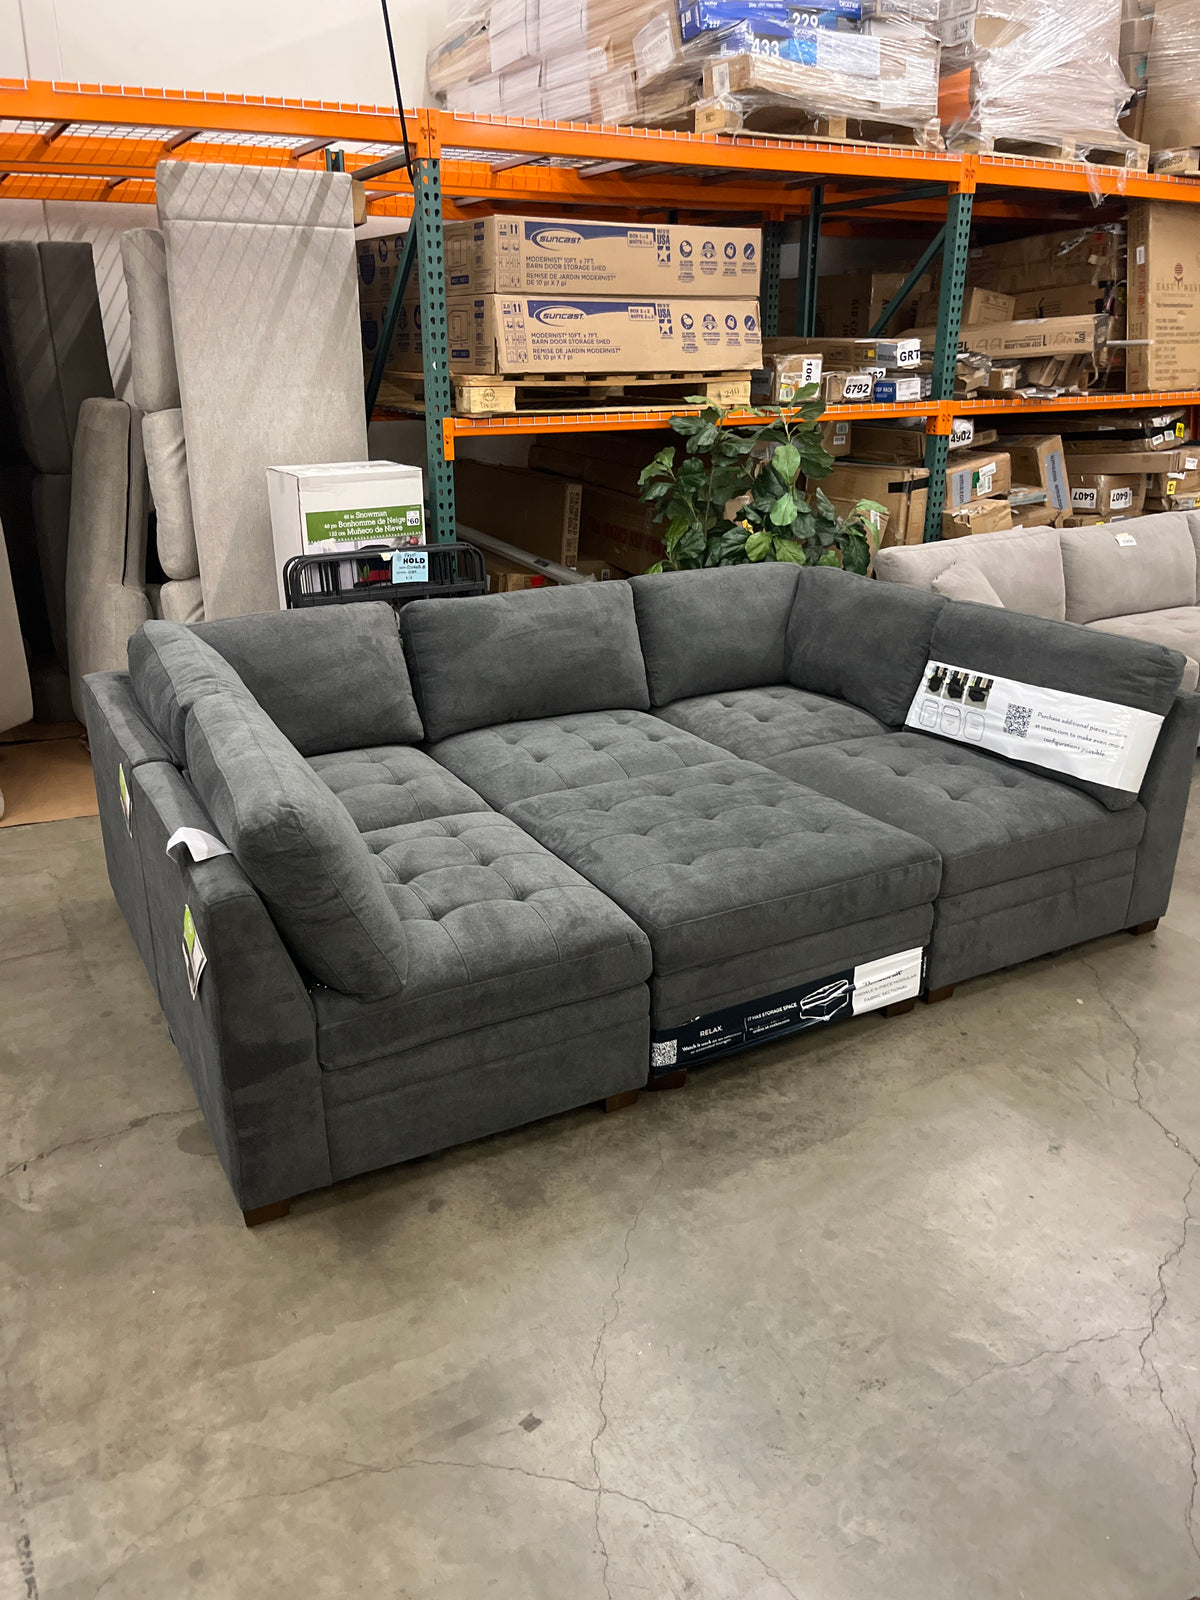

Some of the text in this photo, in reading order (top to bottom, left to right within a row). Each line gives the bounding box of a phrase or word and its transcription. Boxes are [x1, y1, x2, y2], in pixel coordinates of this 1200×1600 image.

[792, 12, 819, 28] 229
[751, 38, 780, 57] 433
[657, 234, 670, 245] USA
[658, 308, 671, 318] USA
[899, 350, 920, 362] GRT
[845, 383, 870, 395] 6792
[951, 431, 971, 443] 4902
[1073, 491, 1095, 501] 6407
[1112, 491, 1128, 502] 6407
[356, 511, 388, 519] Snowman
[338, 519, 376, 528] Bonhomme
[387, 516, 406, 525] Neige
[347, 528, 373, 536] Muñeco
[384, 525, 403, 533] Nieve
[1037, 711, 1061, 722] Purchase
[1061, 718, 1089, 729] additional
[1089, 726, 1108, 734] pieces
[1041, 726, 1069, 737] costco.com
[1077, 734, 1092, 742] make
[1043, 737, 1080, 751] configurations
[762, 1007, 783, 1018] STORAGE
[783, 1002, 798, 1011] SPACE
[699, 1025, 724, 1038] RELAX
[681, 1043, 697, 1052] Watch
